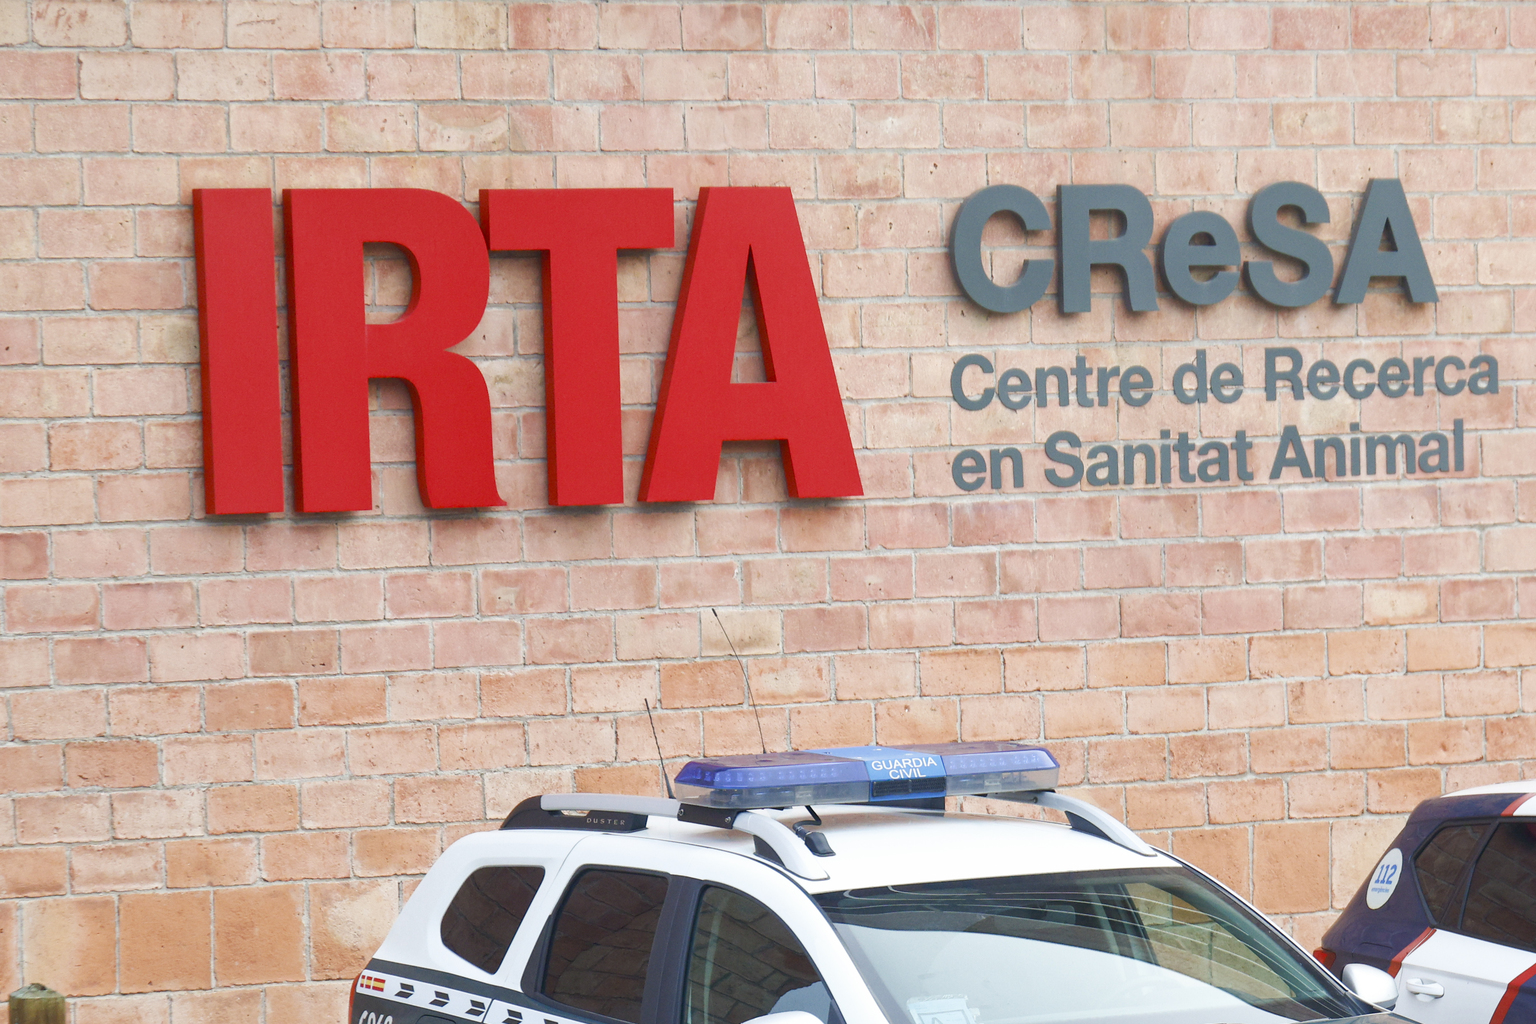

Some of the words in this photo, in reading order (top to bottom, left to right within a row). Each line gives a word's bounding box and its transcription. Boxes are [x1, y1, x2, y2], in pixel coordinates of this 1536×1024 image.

[950, 177, 1440, 315] CReSA
[192, 187, 864, 516] IRTA
[949, 352, 1155, 412] Centre
[1172, 349, 1245, 405] de
[1264, 347, 1501, 402] Recerca
[951, 444, 1026, 492] en
[1043, 428, 1255, 489] Sanitat
[1268, 419, 1465, 481] Animal
[871, 756, 938, 771] GUARDIA
[888, 768, 927, 780] CIVIL
[1374, 863, 1398, 885] 112
